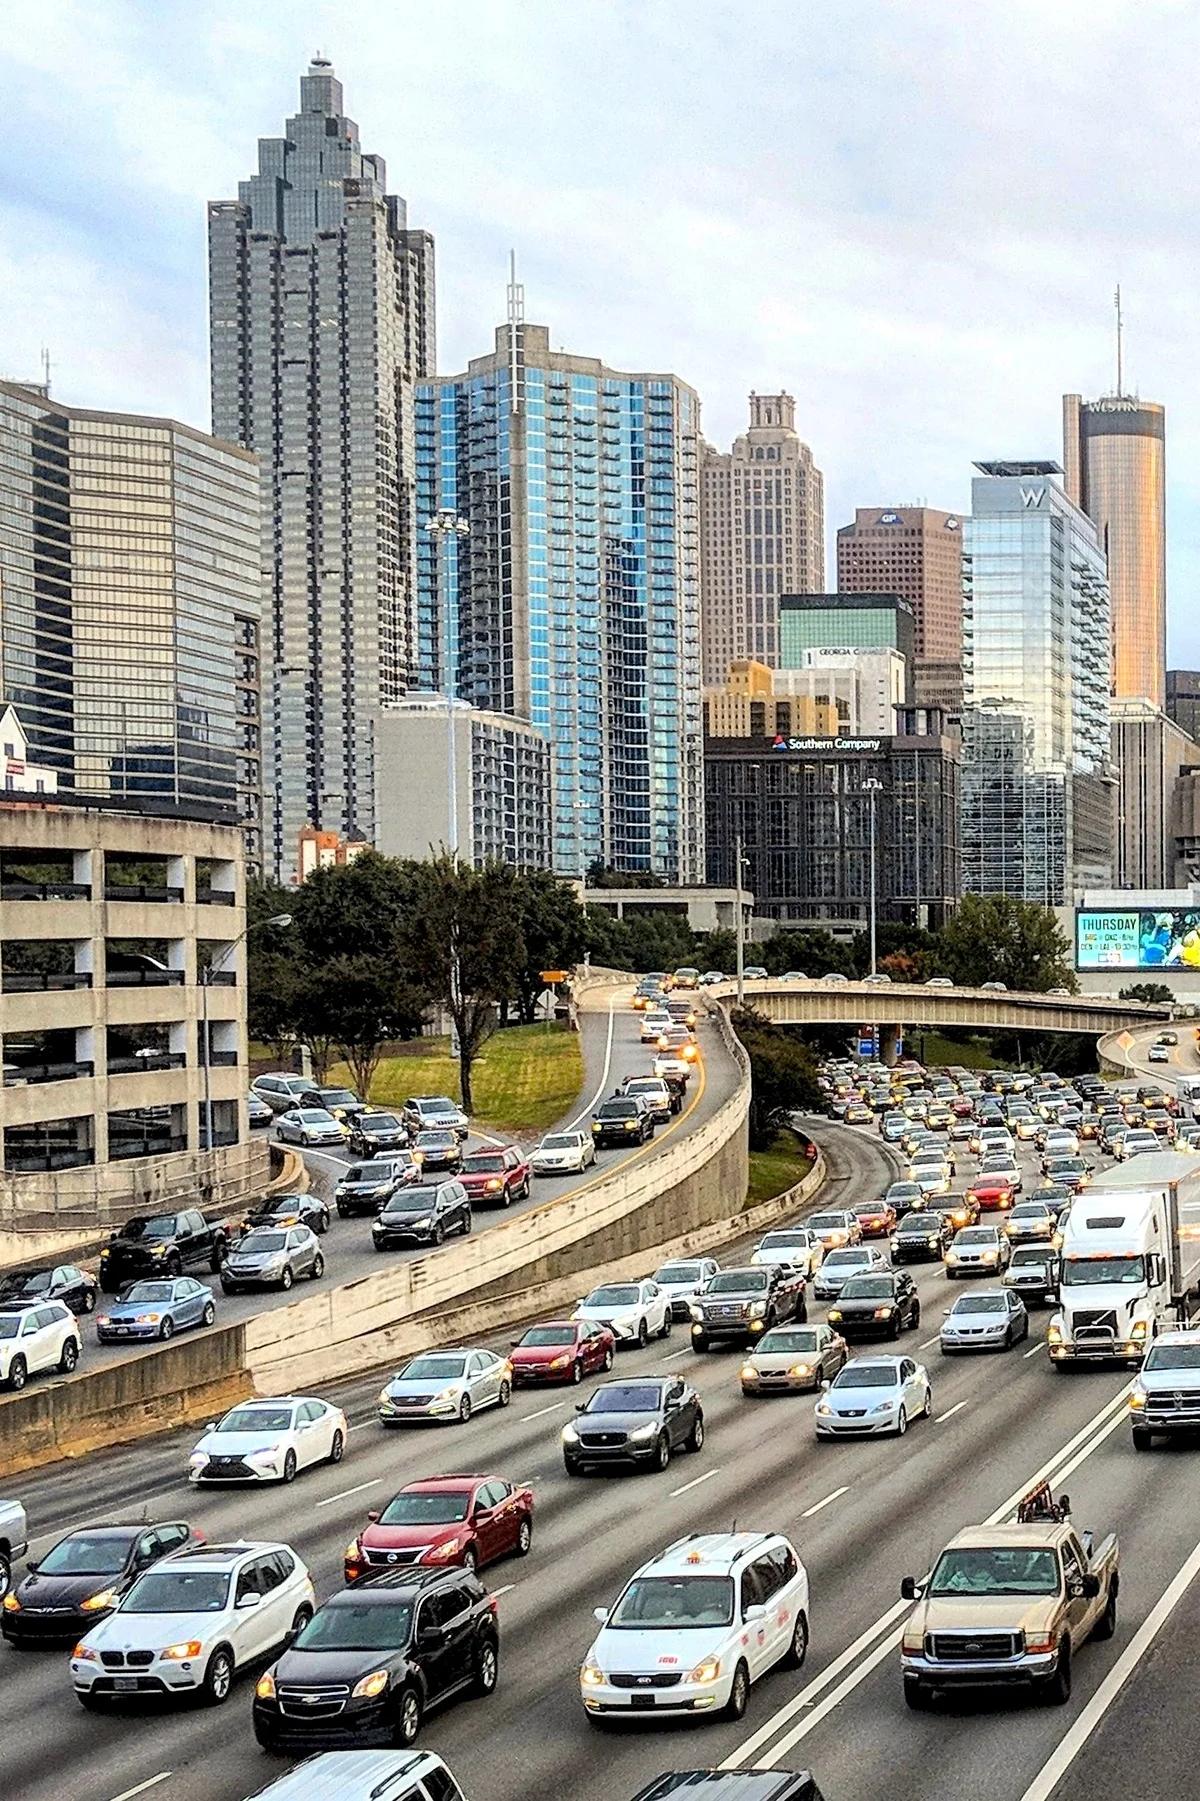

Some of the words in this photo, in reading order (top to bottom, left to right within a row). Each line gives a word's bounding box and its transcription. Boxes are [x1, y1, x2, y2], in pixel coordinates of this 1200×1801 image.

[1020, 487, 1046, 508] W
[788, 738, 833, 750] Southern
[834, 737, 880, 751] Company
[1082, 918, 1137, 931] THURSDAY
